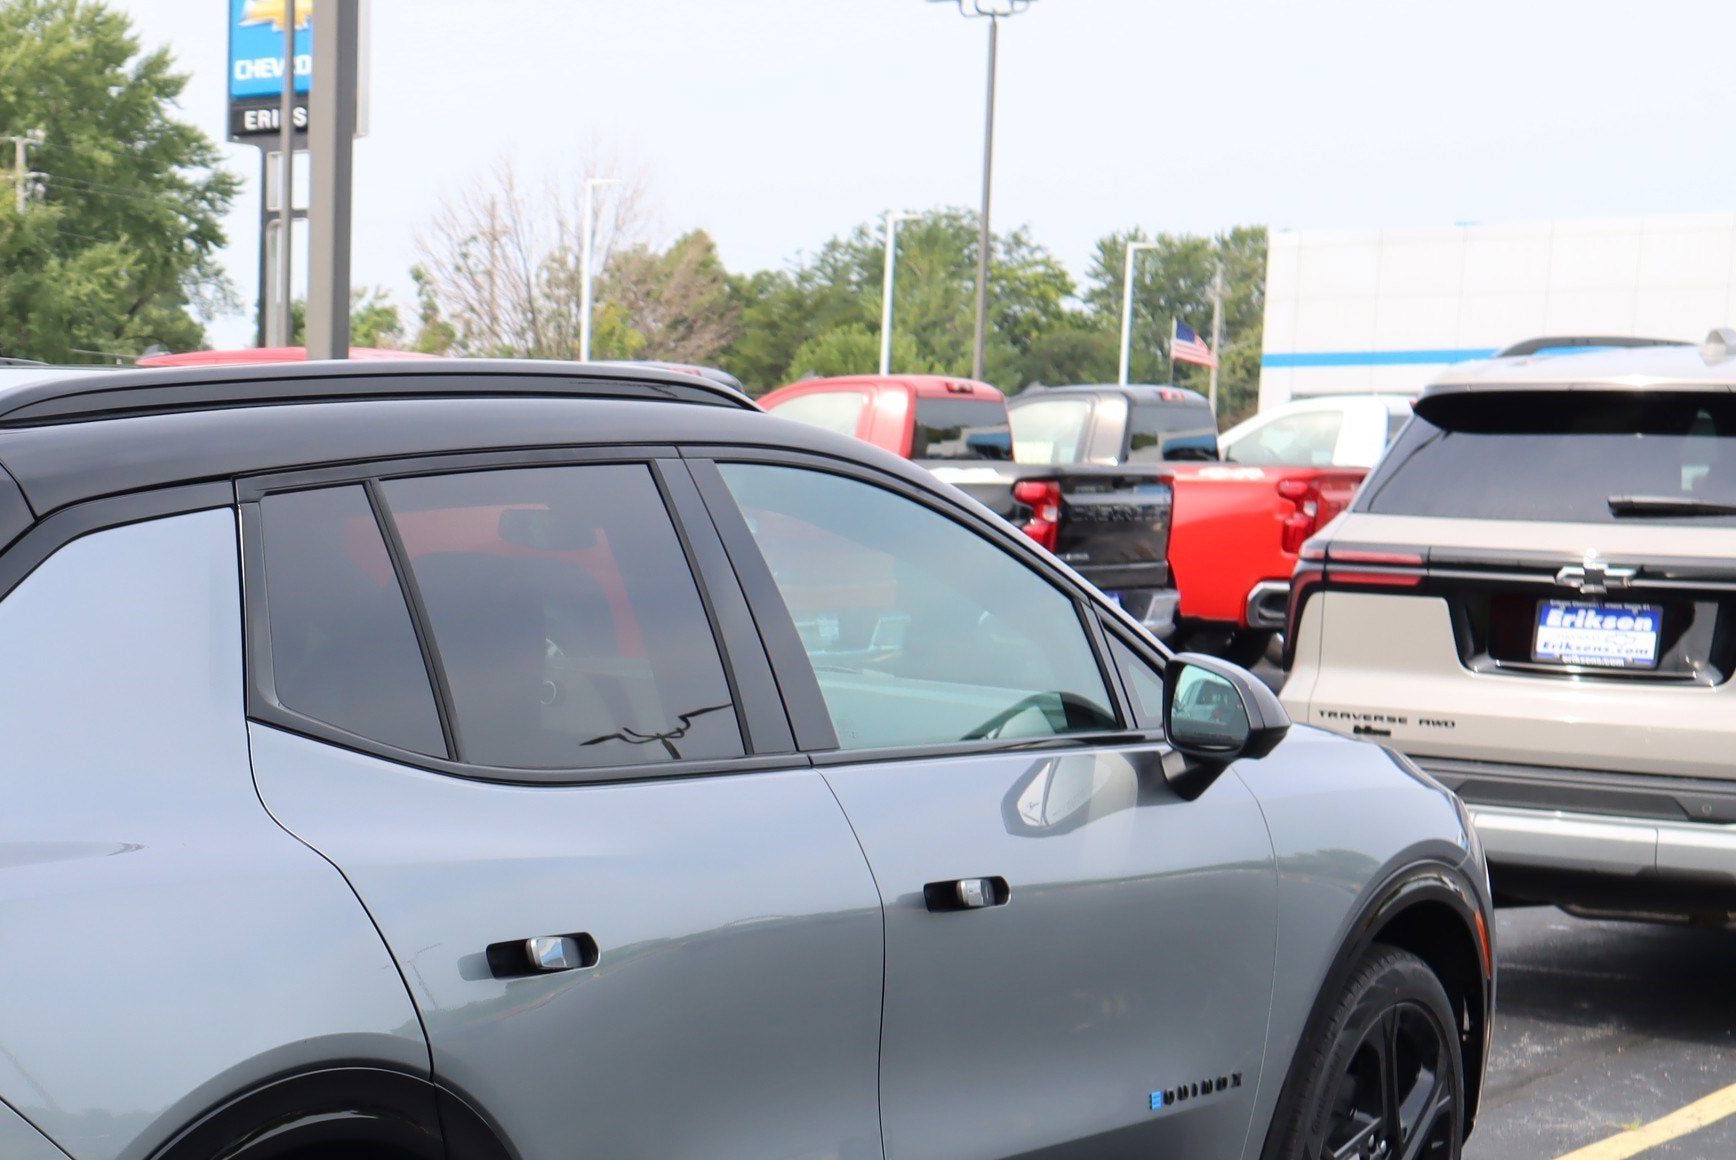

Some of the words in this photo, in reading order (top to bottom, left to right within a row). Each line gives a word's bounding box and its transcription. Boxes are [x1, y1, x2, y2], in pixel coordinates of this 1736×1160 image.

[234, 54, 312, 80] CHEVO
[244, 106, 307, 130] ERIS
[1546, 608, 1653, 632] Eriksen
[1318, 710, 1408, 725] TRAVERSE
[1419, 718, 1456, 729] AWD
